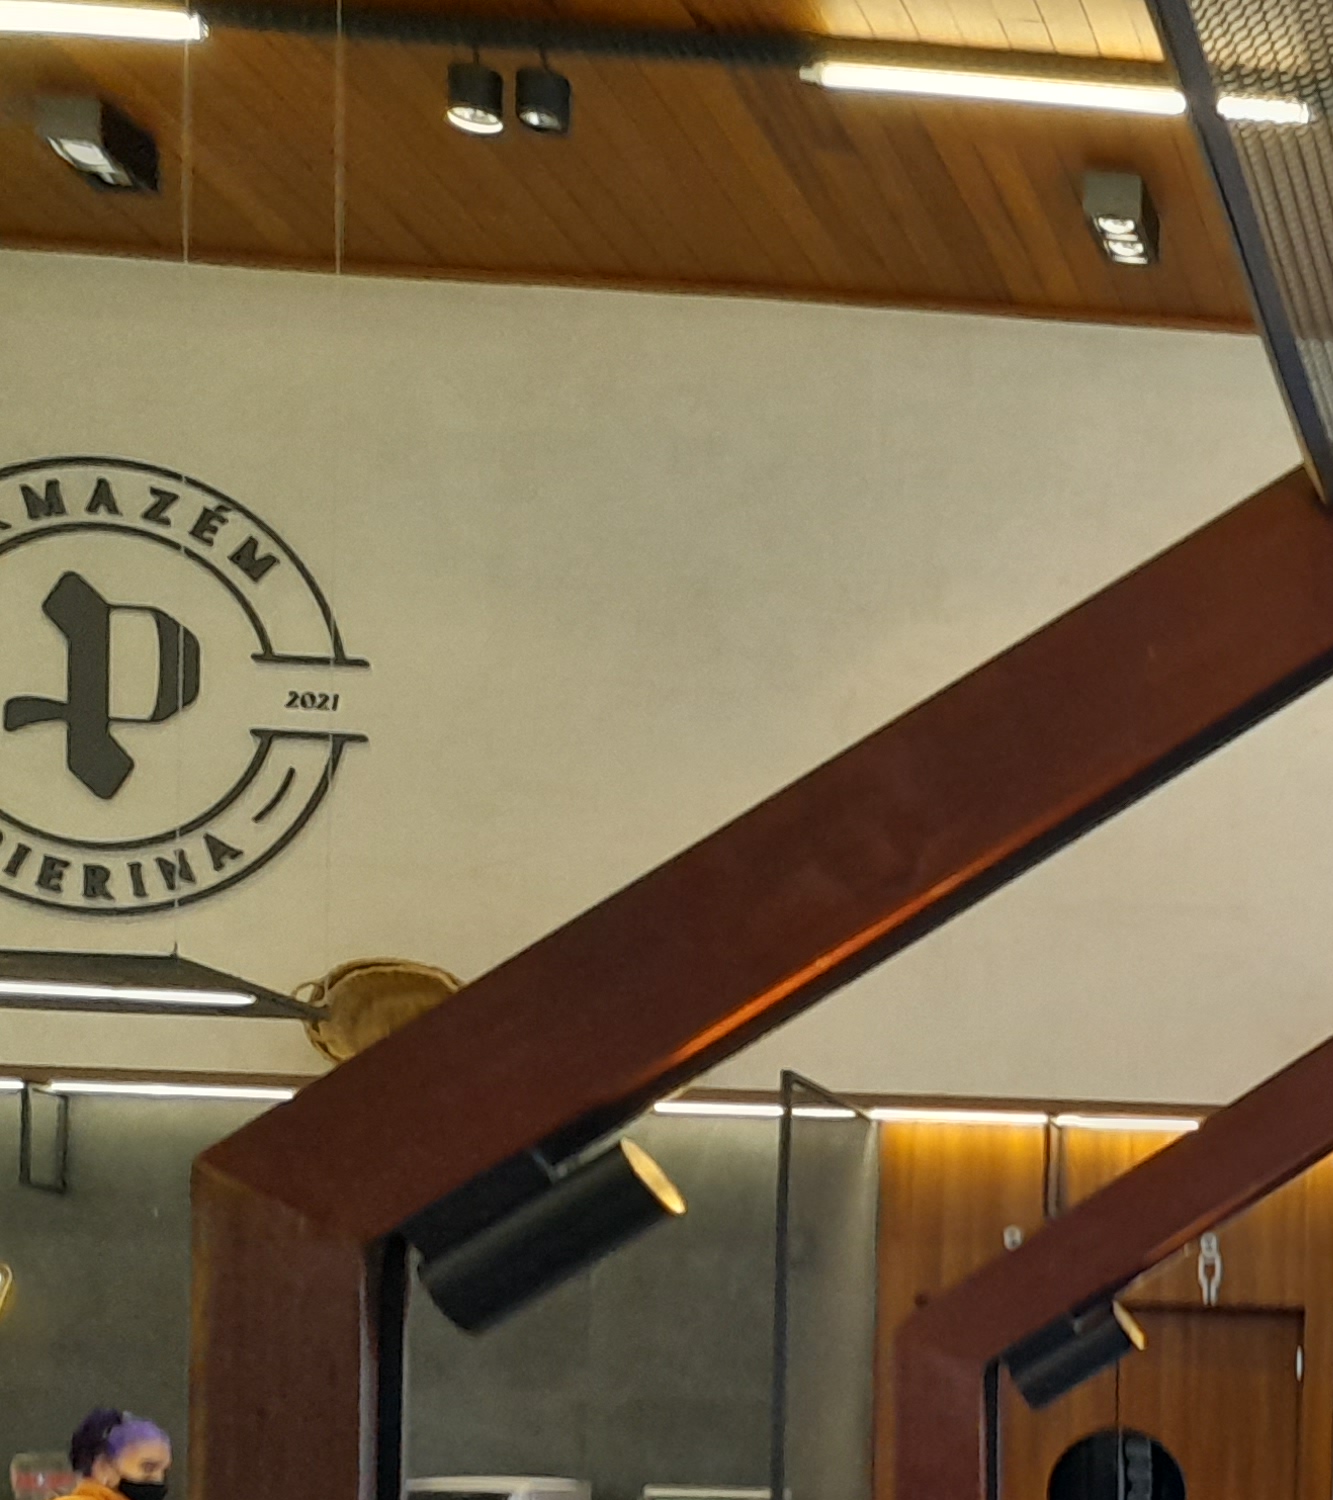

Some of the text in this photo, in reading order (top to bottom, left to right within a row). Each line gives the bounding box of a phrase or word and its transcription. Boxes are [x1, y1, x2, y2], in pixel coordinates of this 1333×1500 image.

[0, 477, 281, 584] MAZÉM
[284, 689, 341, 713] 2021
[0, 832, 245, 902] IERINA
